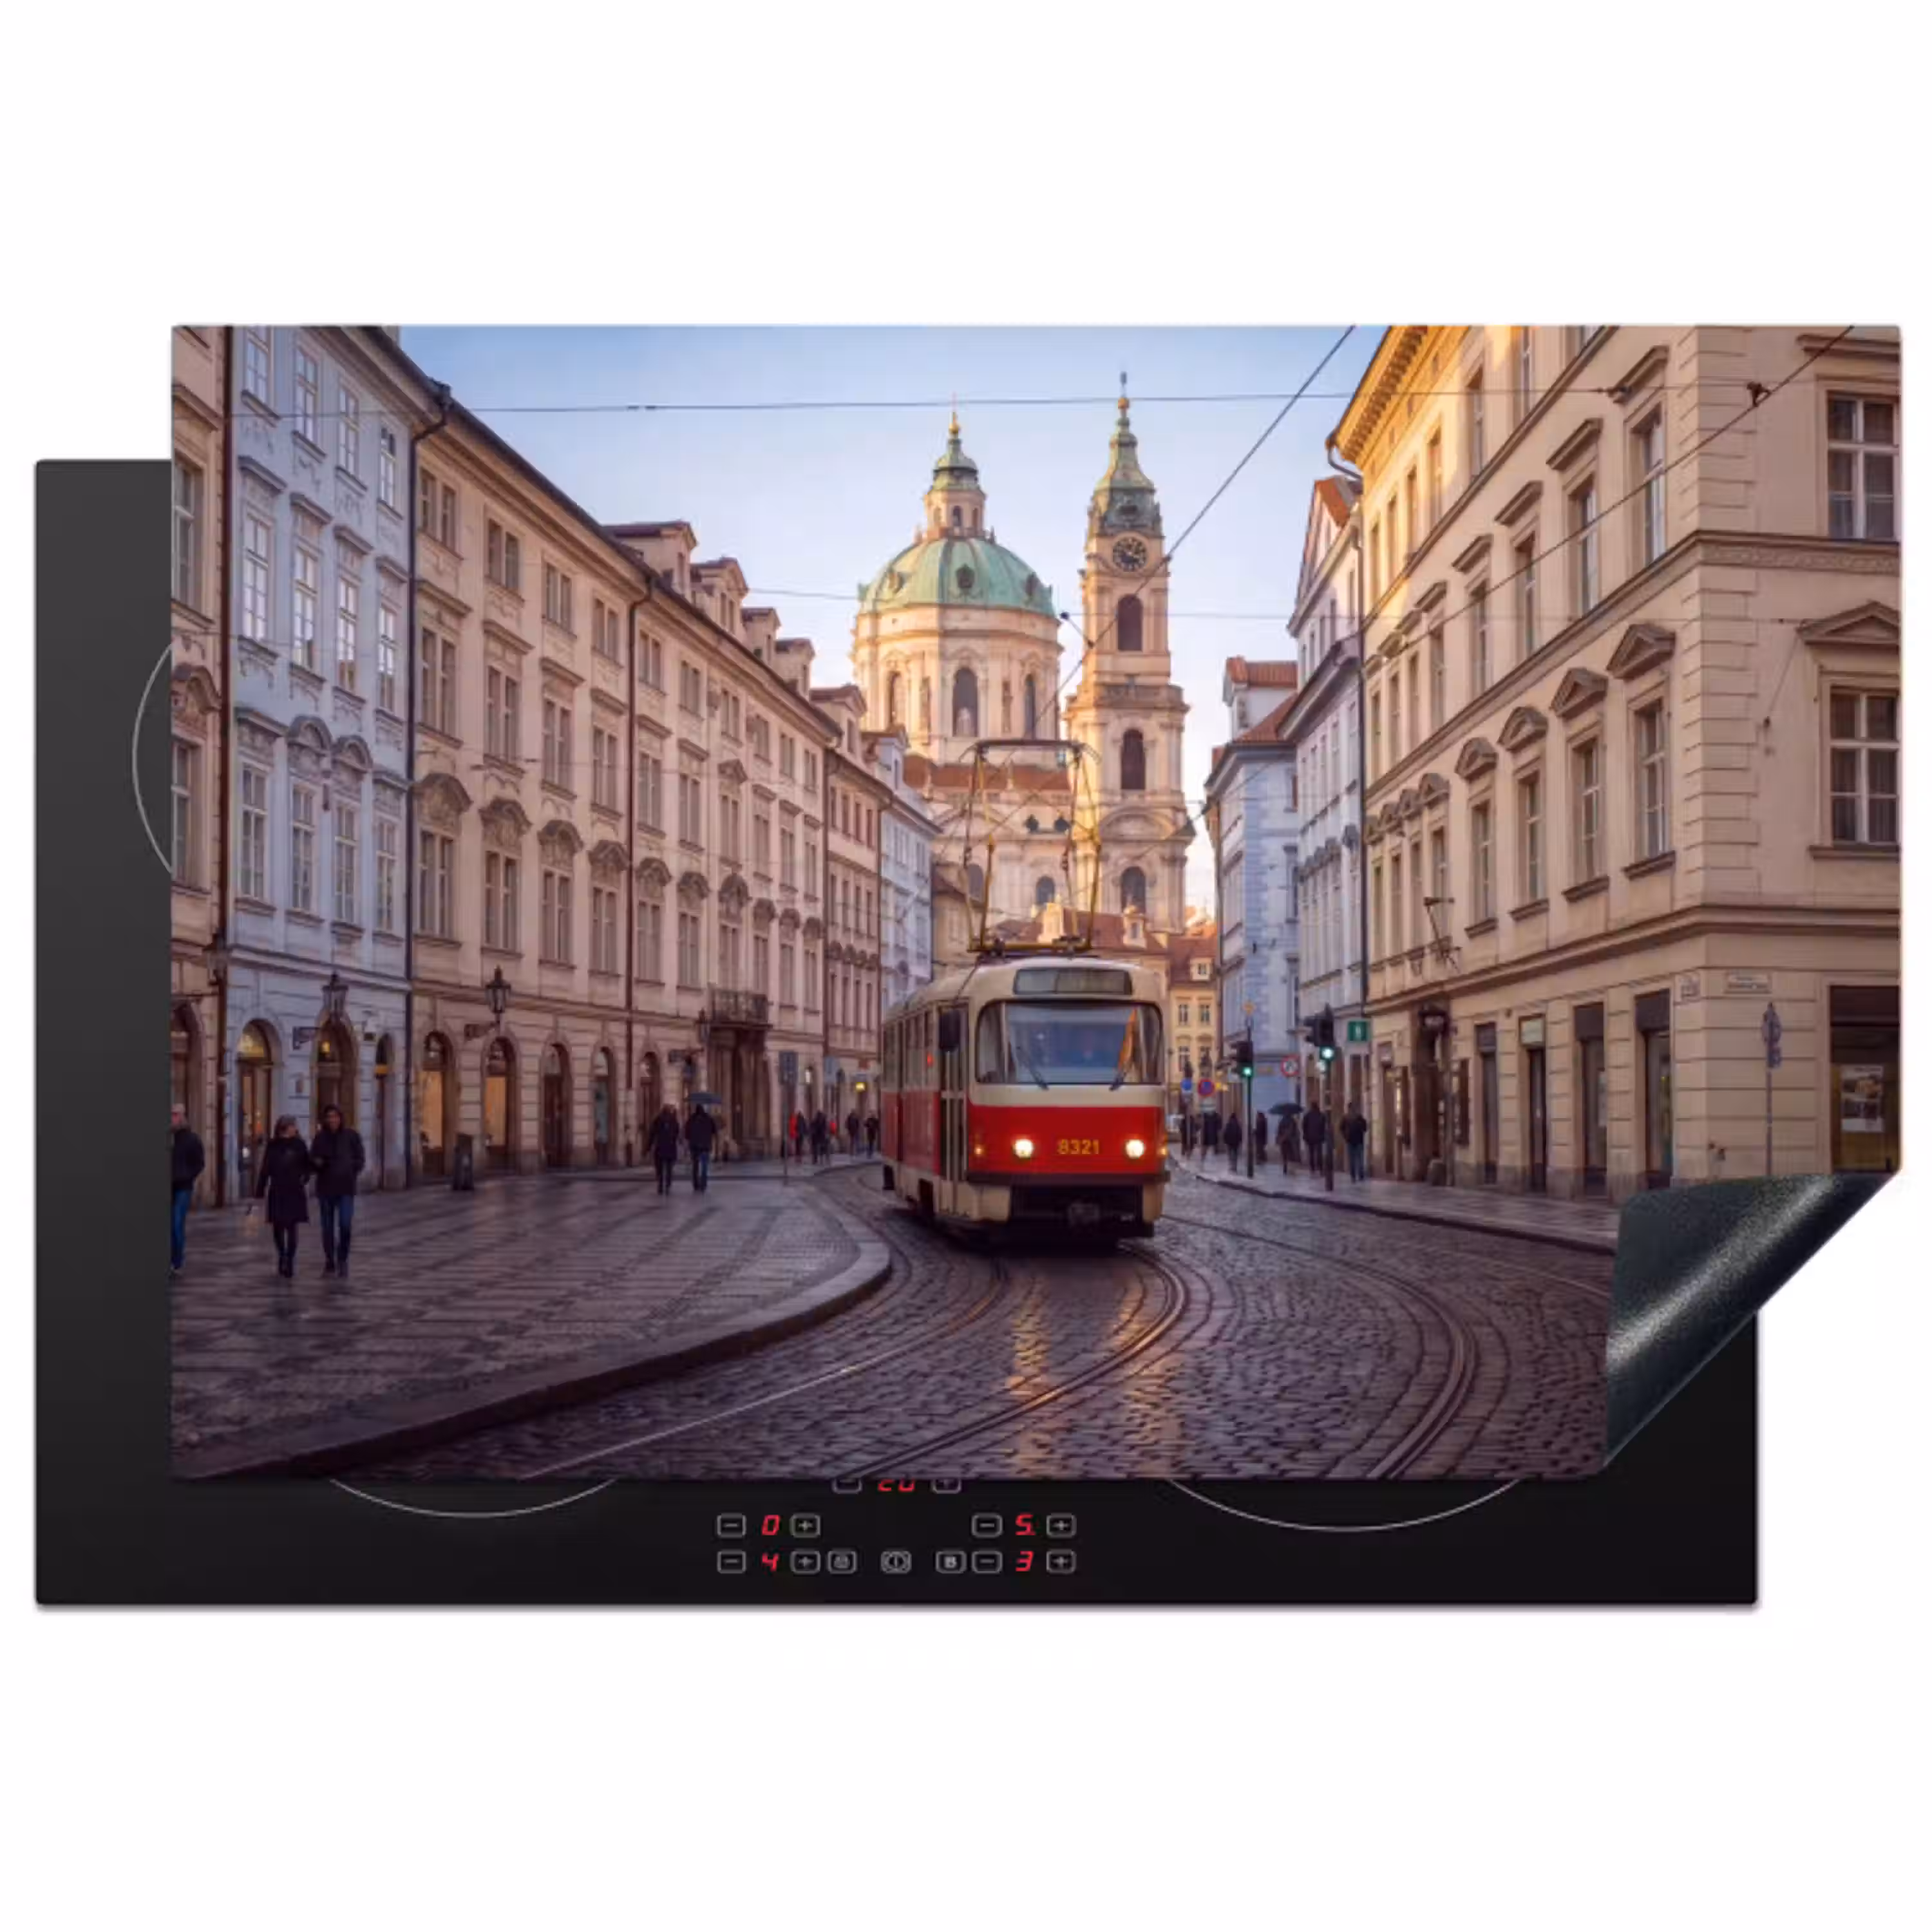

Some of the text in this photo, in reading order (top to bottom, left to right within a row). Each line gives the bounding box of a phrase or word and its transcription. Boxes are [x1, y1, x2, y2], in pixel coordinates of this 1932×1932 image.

[1057, 1139, 1099, 1155] 8321
[762, 1514, 780, 1536] 0
[762, 1552, 779, 1571] 4
[1015, 1550, 1034, 1572] 3
